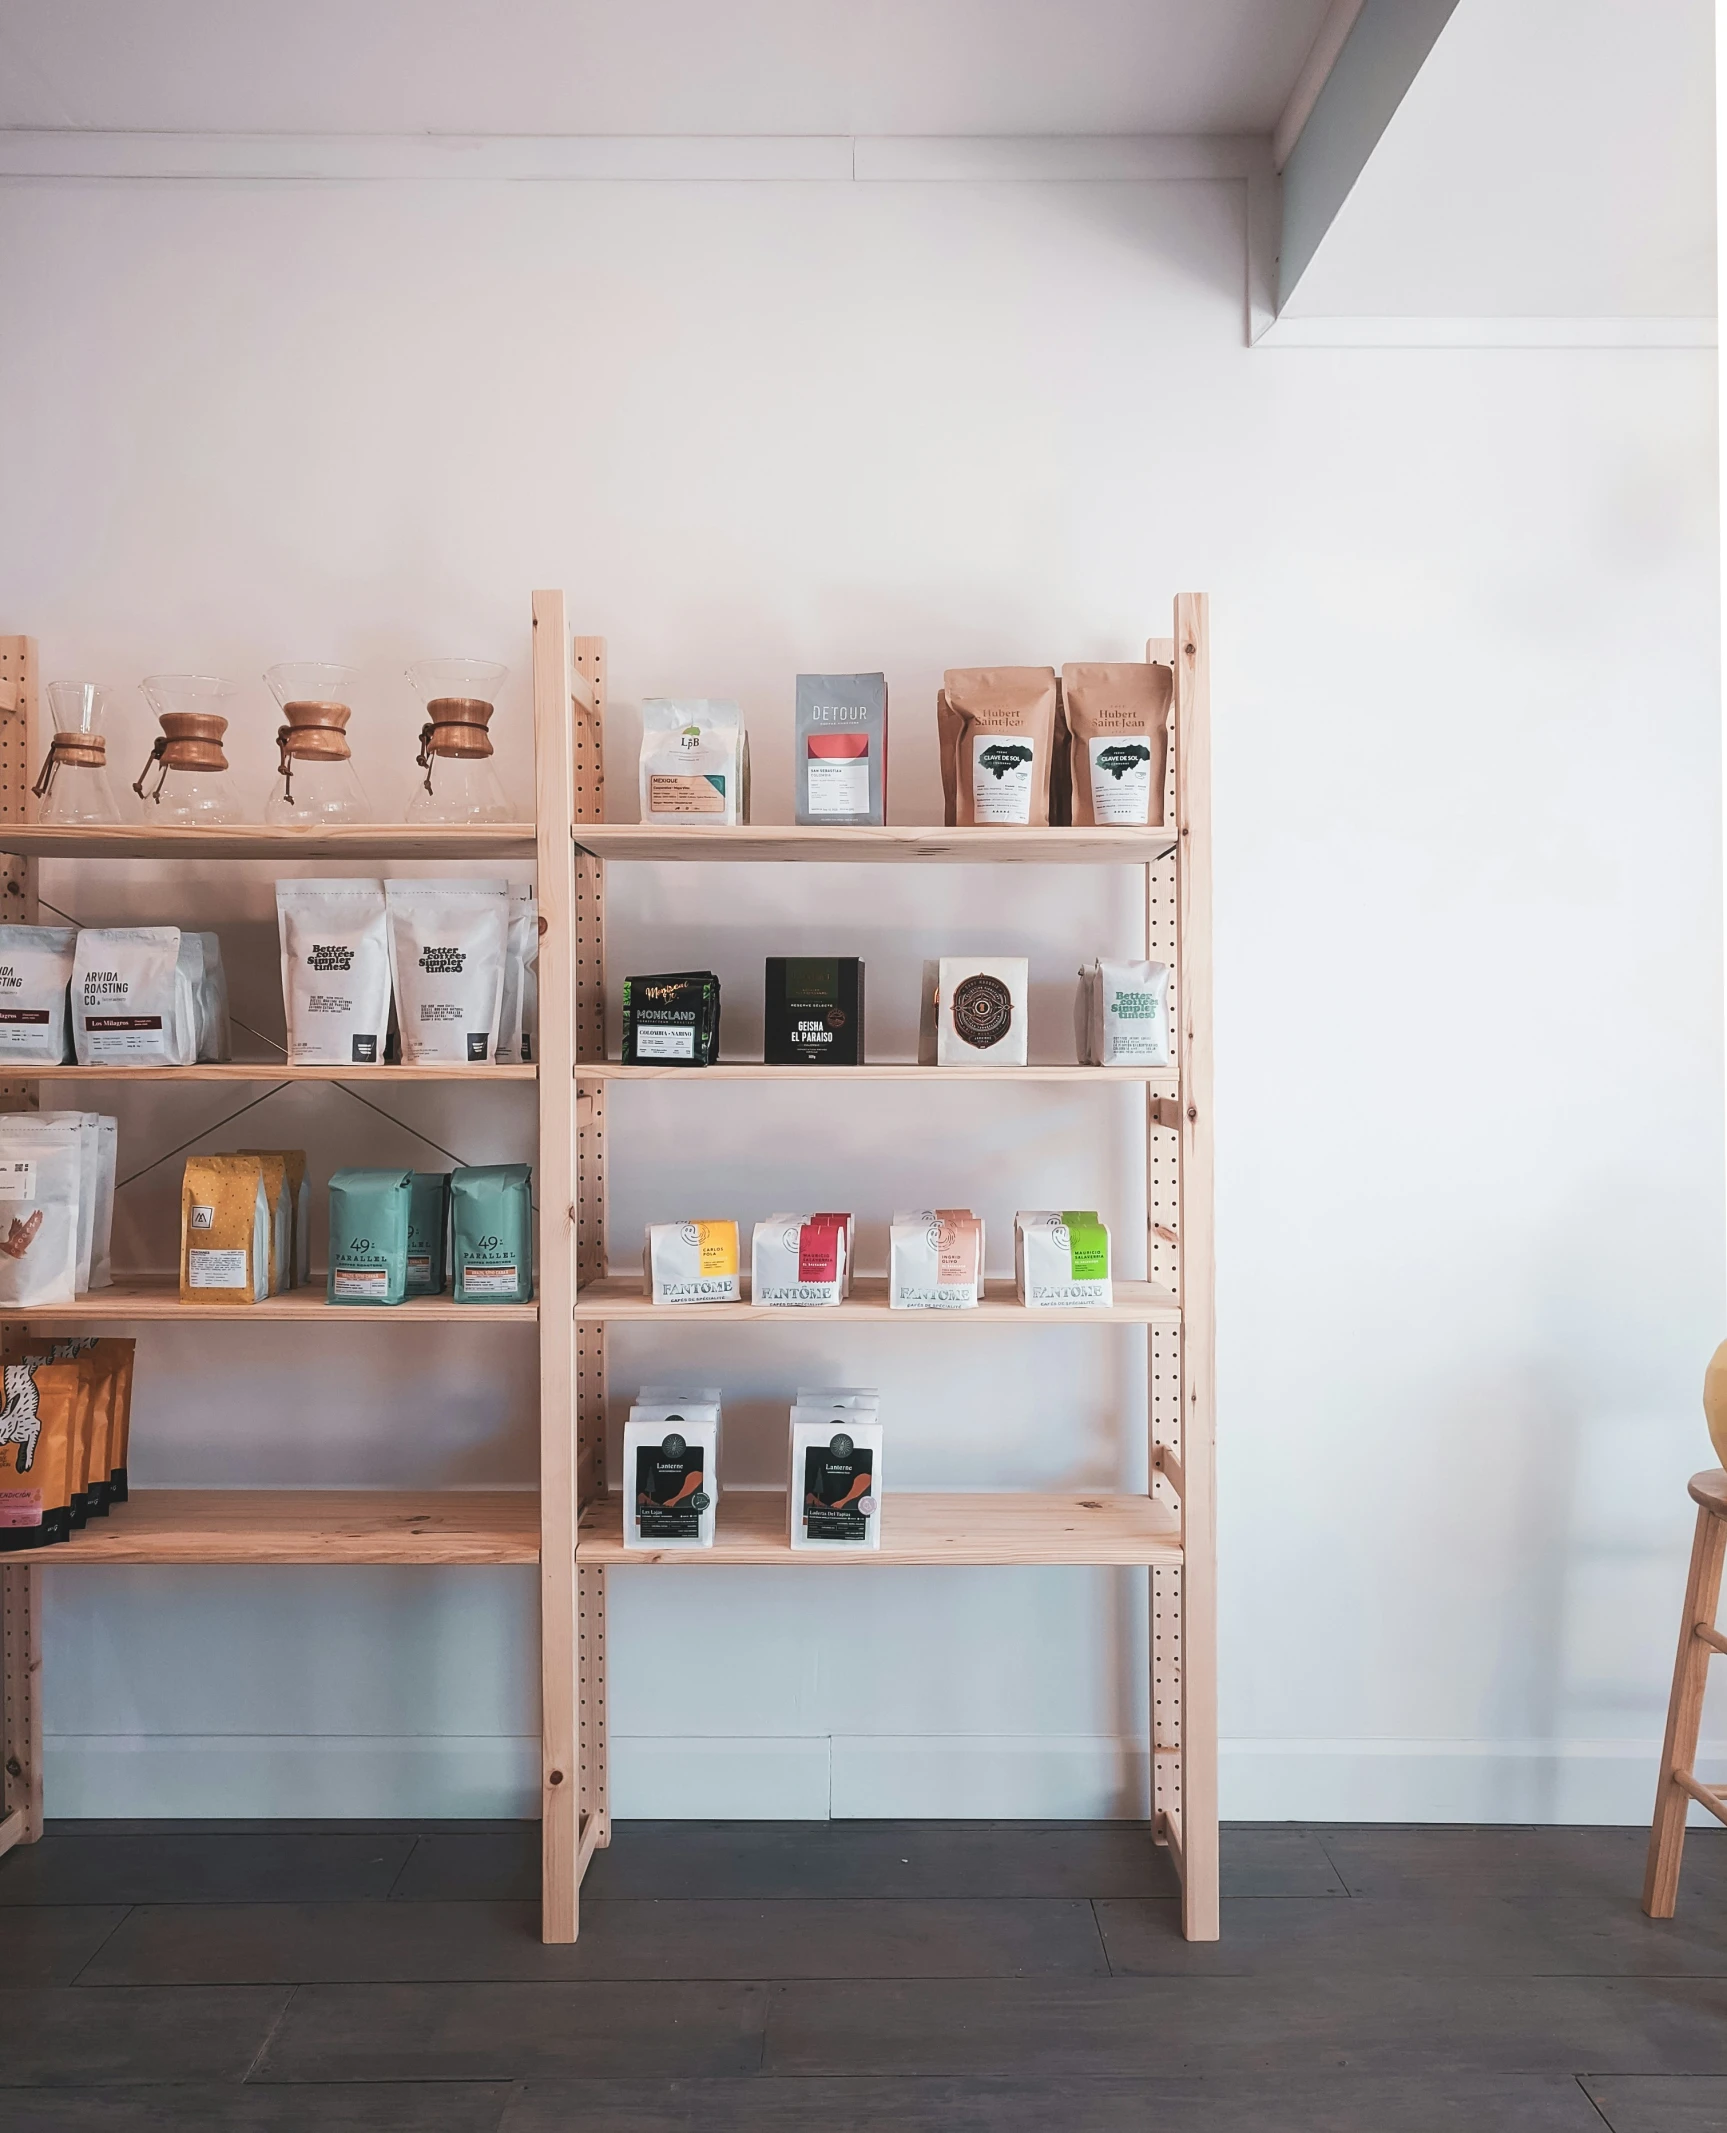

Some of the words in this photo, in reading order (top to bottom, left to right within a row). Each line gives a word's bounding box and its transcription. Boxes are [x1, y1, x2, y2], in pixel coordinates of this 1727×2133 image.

[813, 705, 867, 720] DETOUR
[983, 709, 1020, 718] Hubert
[1099, 710, 1137, 718] Hubert
[1091, 718, 1145, 728] Saint-Jean
[312, 945, 347, 953] Better
[307, 956, 351, 965] Simpler
[418, 958, 463, 967] Simpler
[85, 972, 118, 982] ARVIDA
[84, 983, 129, 994] ROASTING
[1115, 991, 1153, 1000] Better
[1111, 1004, 1157, 1013] Simpler
[636, 1009, 696, 1021] MONKLAND
[798, 1021, 824, 1032] GEISHA
[791, 1031, 800, 1042] EL
[801, 1032, 833, 1042] PARAISO
[335, 1254, 387, 1262] PARALLEL
[662, 1280, 733, 1295] FANTÔME
[761, 1285, 832, 1299] FANTÔME
[1032, 1283, 1103, 1298] FANTÔME
[825, 1463, 853, 1471] Lanterne
